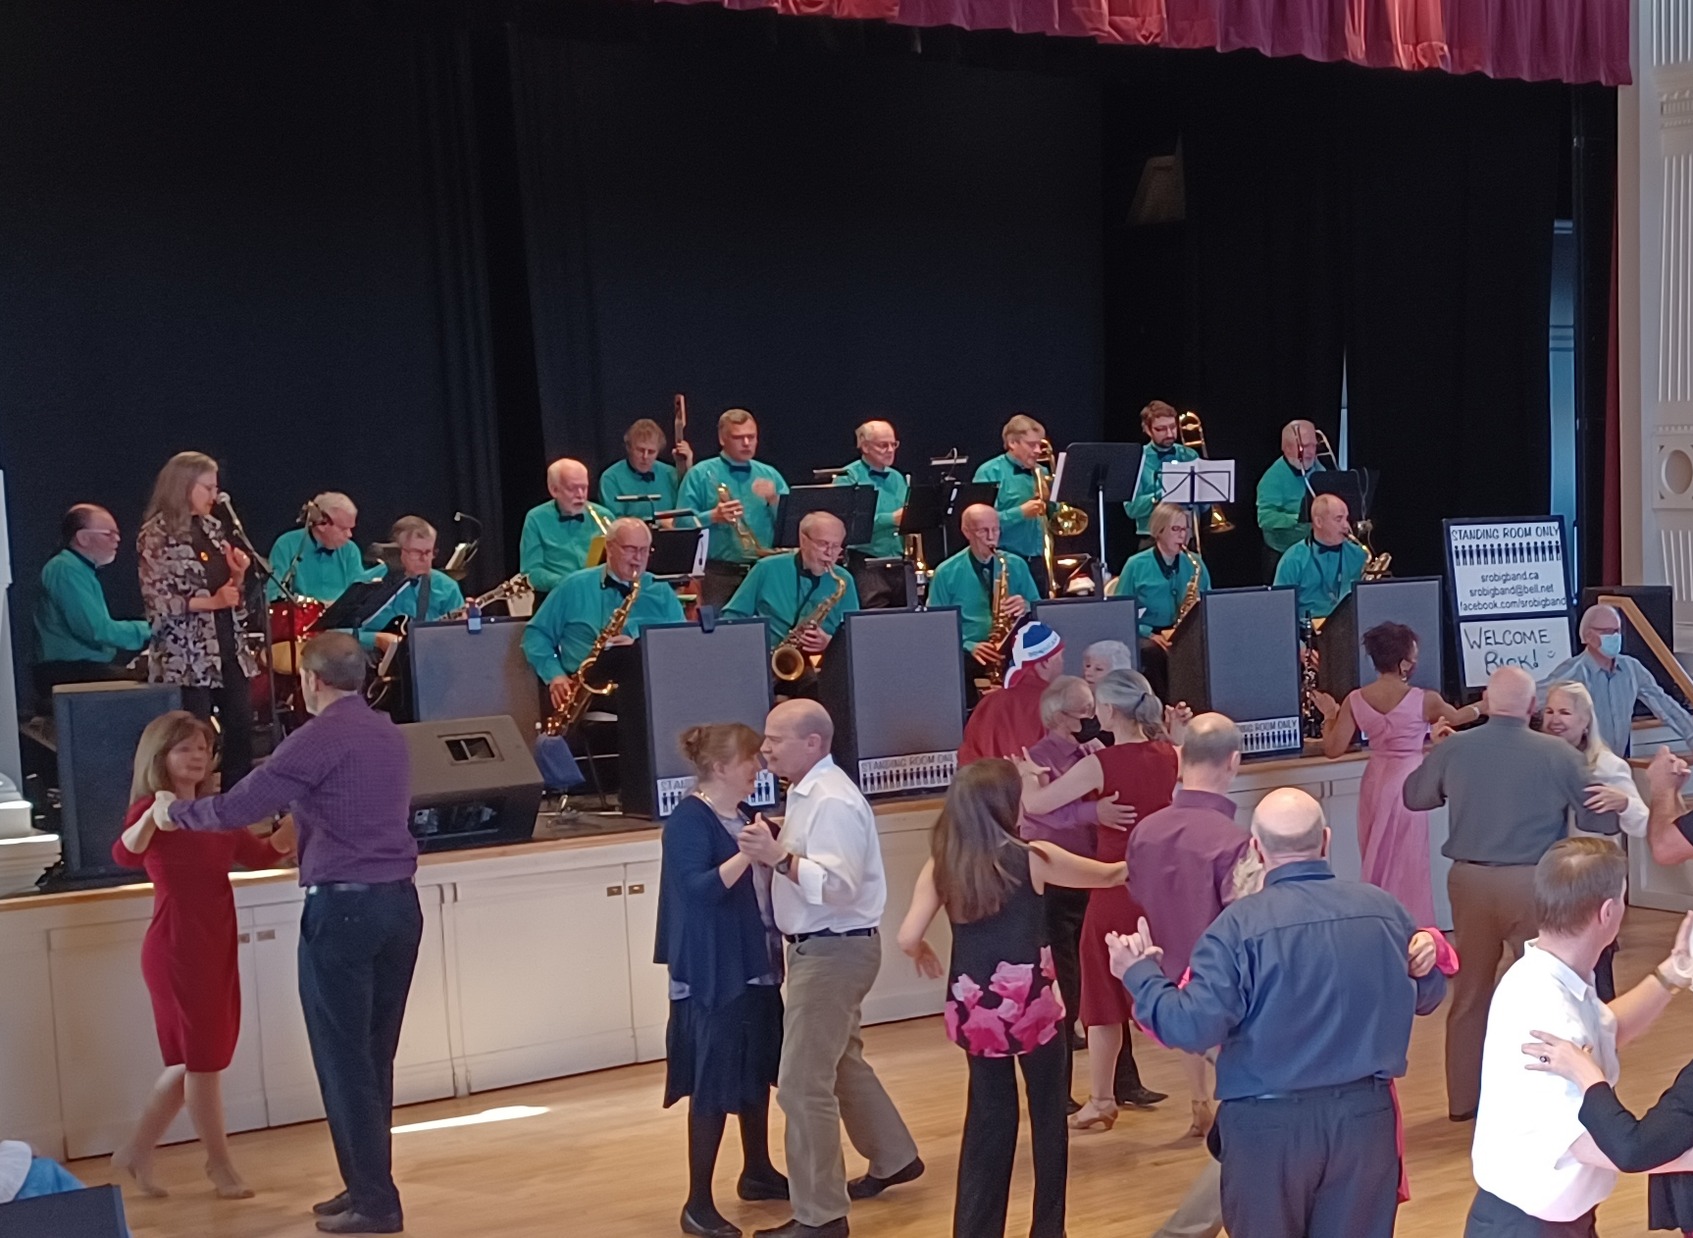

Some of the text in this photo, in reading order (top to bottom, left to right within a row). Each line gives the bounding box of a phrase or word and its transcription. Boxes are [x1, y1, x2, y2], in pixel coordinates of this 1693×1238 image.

[1451, 525, 1560, 541] STANDING ROOM ONLY
[1481, 571, 1539, 584] srobigband.ca
[1469, 584, 1554, 598] srobigband@bell.net
[1464, 627, 1551, 649] WELCOME
[937, 753, 957, 764] ONL
